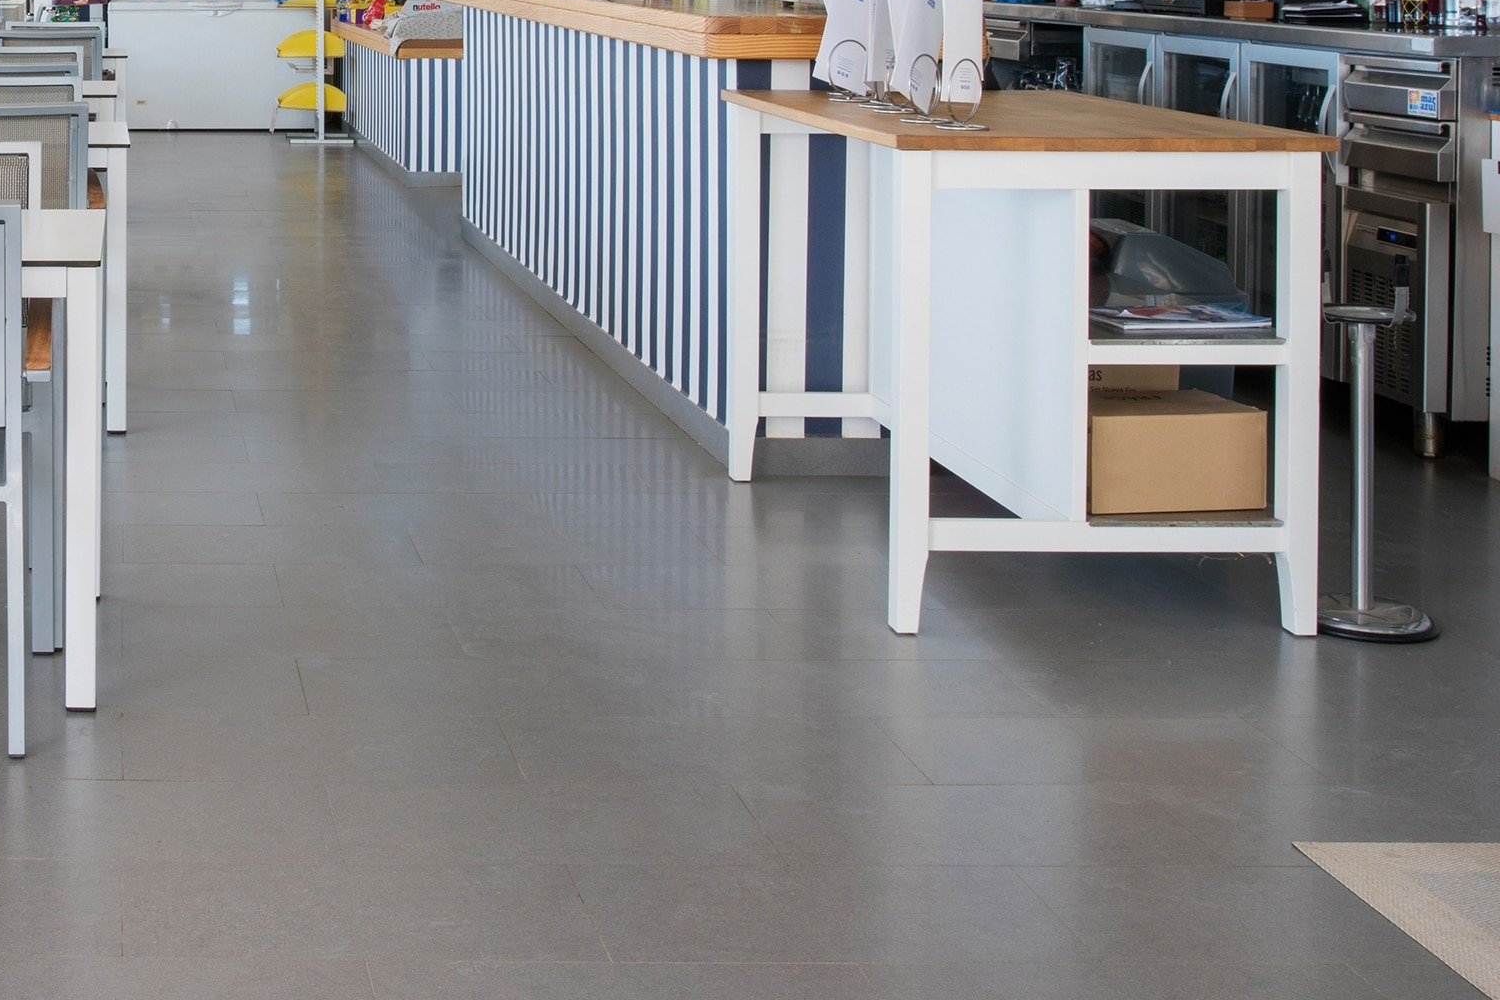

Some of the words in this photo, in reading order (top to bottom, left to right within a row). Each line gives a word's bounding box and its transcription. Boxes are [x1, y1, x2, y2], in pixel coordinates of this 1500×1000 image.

[412, 3, 441, 11] nutella
[1421, 95, 1436, 103] mar
[1420, 102, 1436, 112] azul
